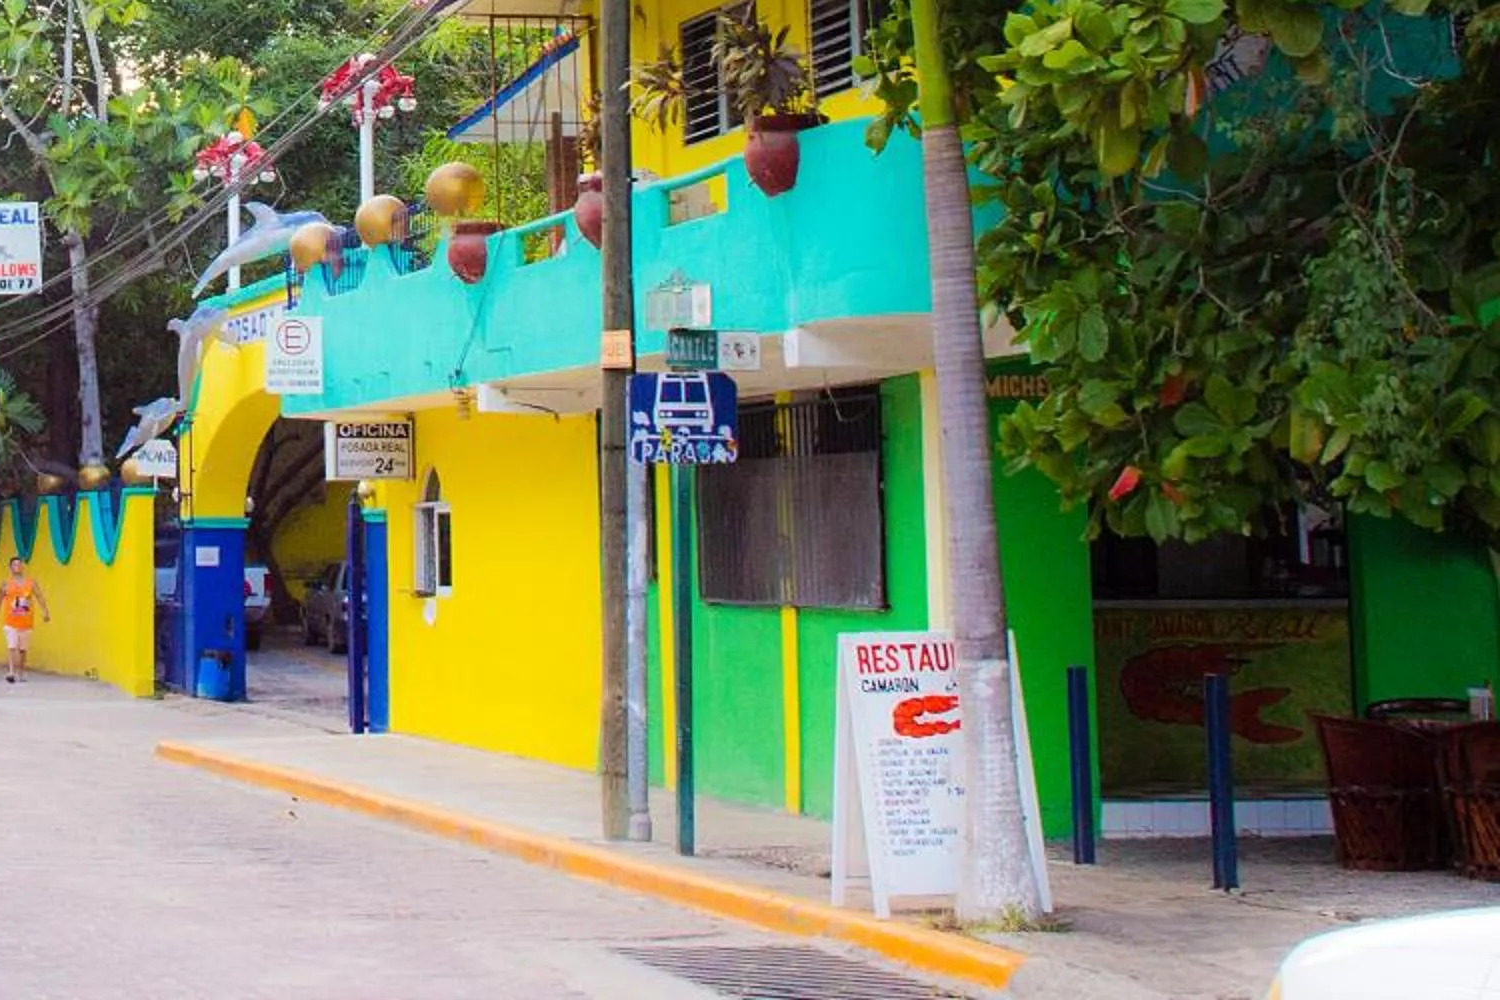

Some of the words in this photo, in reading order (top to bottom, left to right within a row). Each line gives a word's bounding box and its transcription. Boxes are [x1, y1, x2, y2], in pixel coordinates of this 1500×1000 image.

[227, 311, 274, 343] POSAD
[285, 325, 302, 349] E
[339, 423, 407, 437] OFICINA
[341, 440, 380, 453] POSADA
[382, 440, 406, 453] REAL
[375, 457, 394, 474] 24
[856, 642, 955, 675] RESTAU
[861, 677, 920, 693] CAMARON
